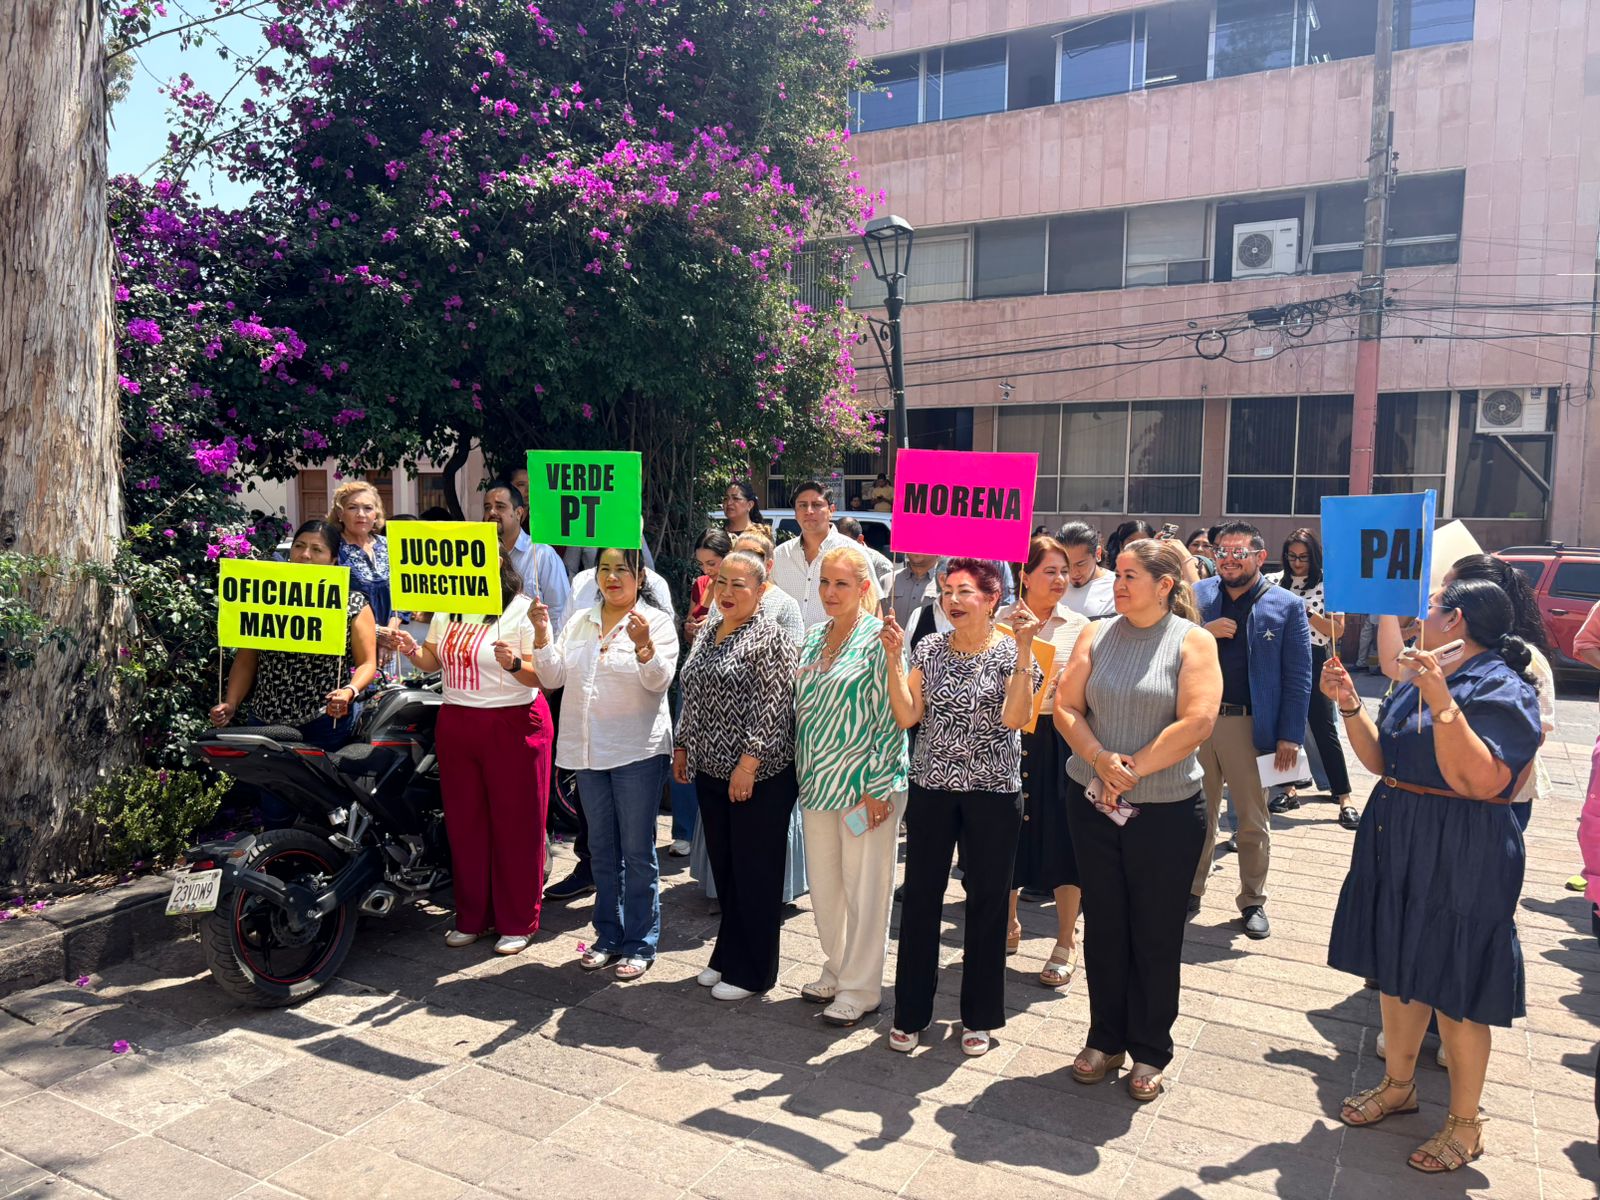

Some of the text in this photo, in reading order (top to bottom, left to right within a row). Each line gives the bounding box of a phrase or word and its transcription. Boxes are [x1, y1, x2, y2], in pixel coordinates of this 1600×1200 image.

[545, 463, 615, 492] VERDE
[560, 495, 602, 537] PT
[903, 483, 1022, 521] MORENA
[400, 537, 487, 568] JUCOPO
[222, 577, 342, 610] OFICIALÍA
[401, 573, 489, 597] DIRECTIVA
[239, 610, 323, 642] MAYOR
